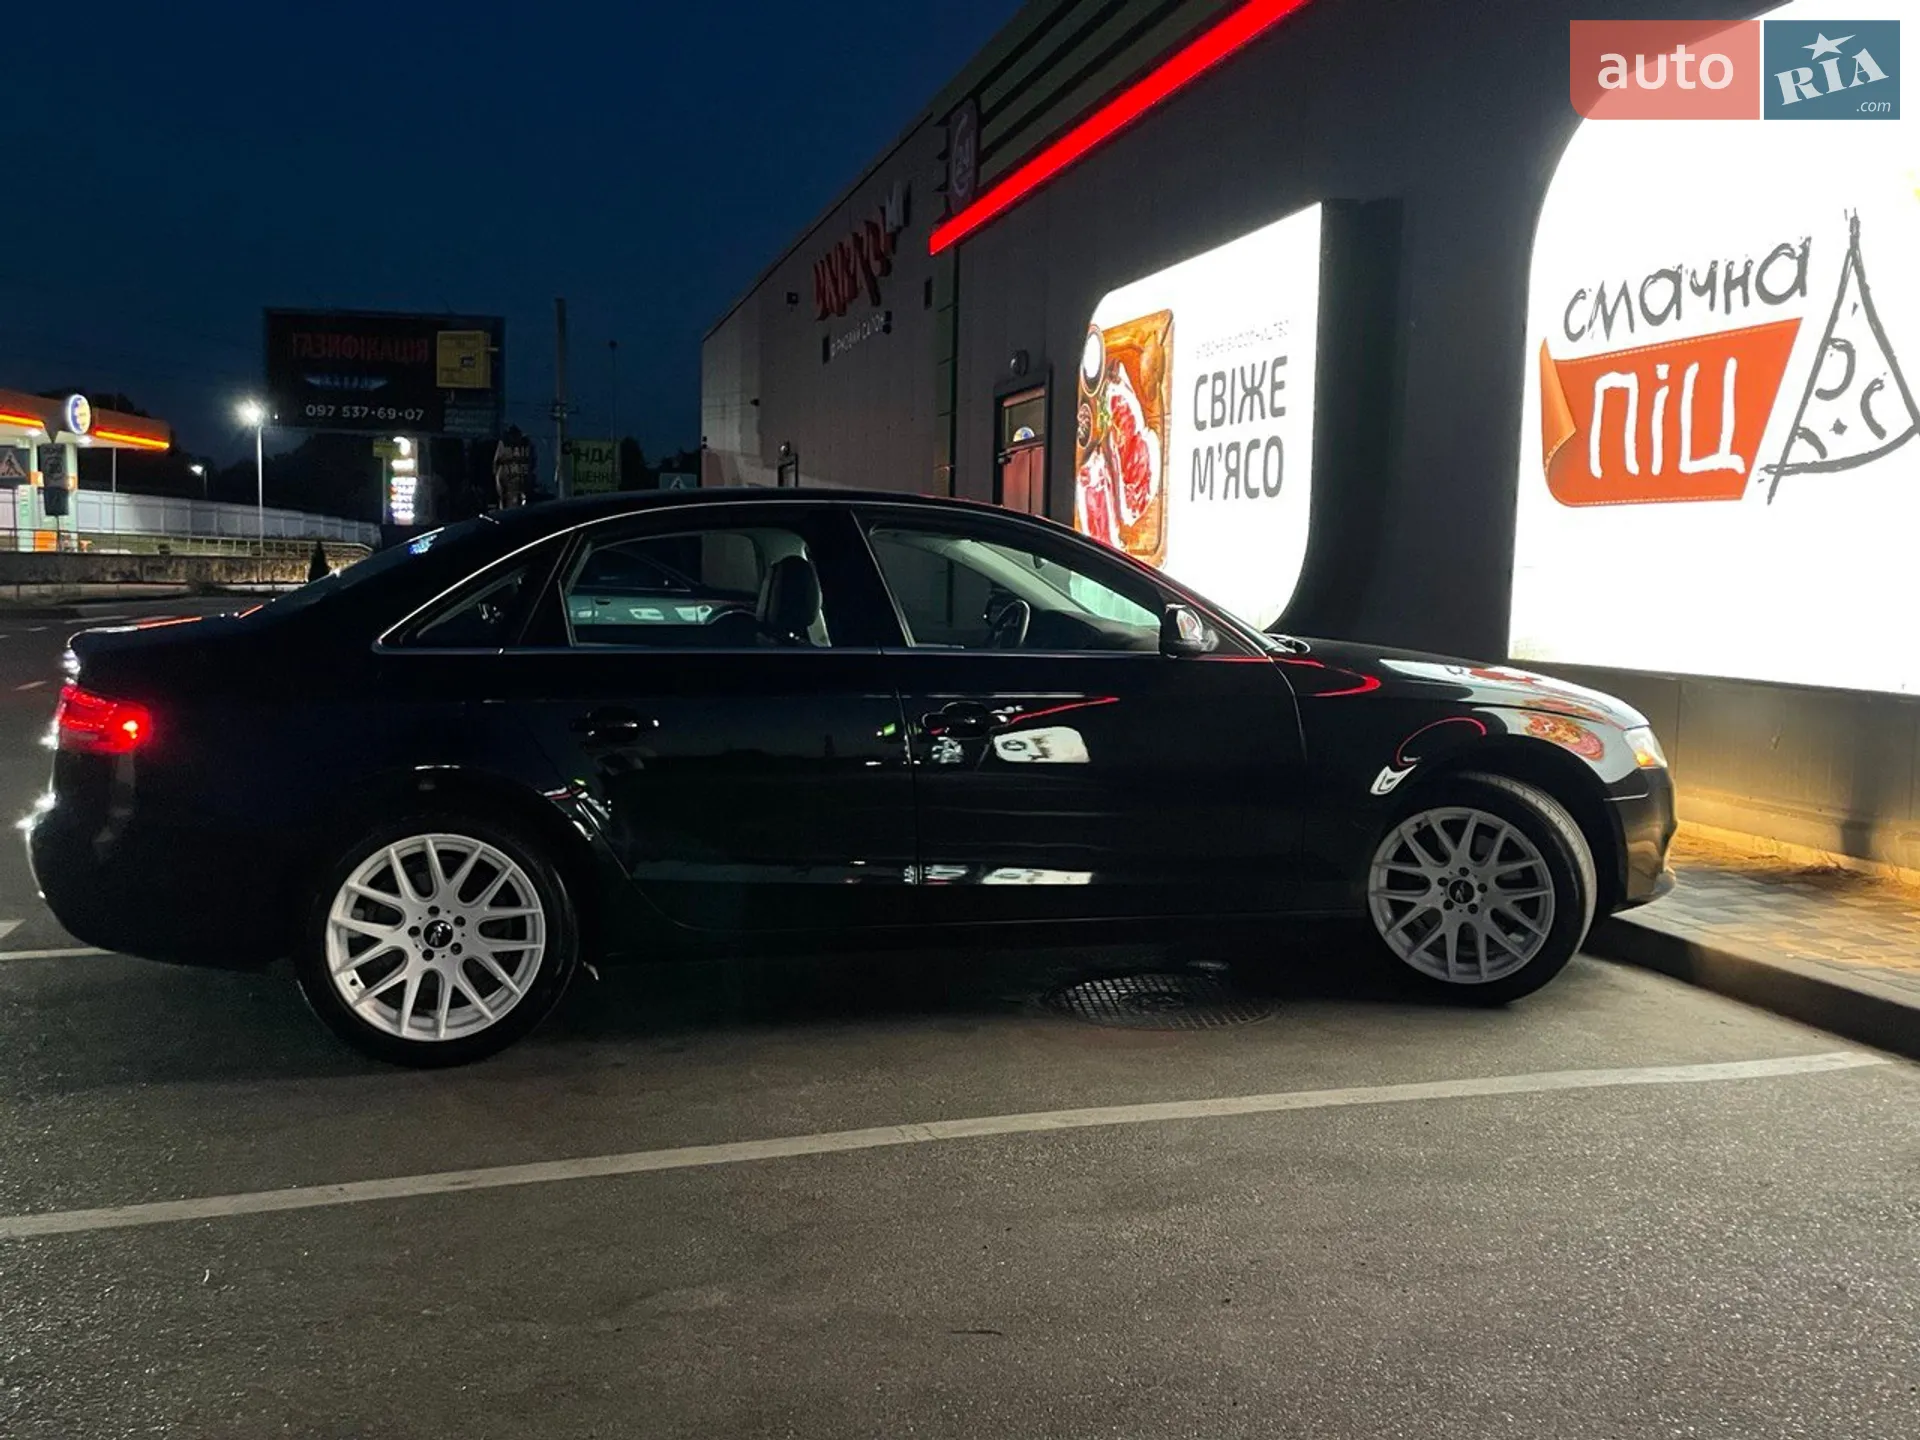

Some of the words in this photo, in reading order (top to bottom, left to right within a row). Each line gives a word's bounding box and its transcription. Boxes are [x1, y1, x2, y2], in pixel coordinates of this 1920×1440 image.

[305, 404, 336, 417] 097
[1194, 355, 1288, 431] СВІЖЕ
[1191, 435, 1284, 502] М'ЯСО
